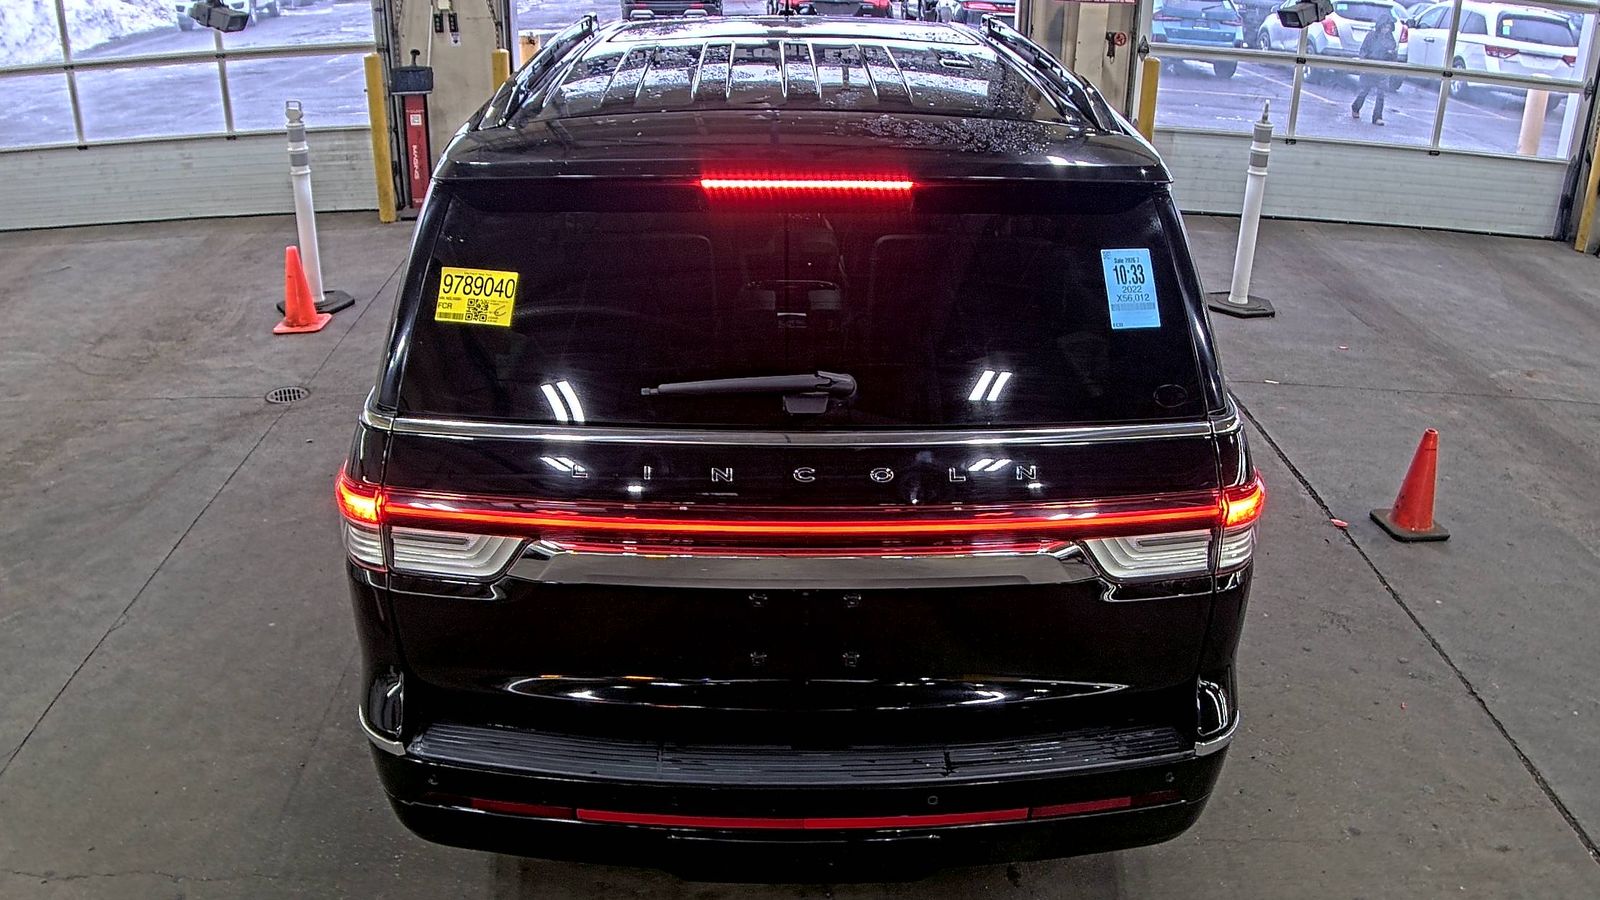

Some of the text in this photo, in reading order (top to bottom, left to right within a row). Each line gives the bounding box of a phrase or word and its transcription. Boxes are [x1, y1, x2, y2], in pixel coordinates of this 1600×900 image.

[1113, 264, 1145, 285] 10:33
[442, 273, 516, 299] 9789040
[1122, 285, 1142, 294] 2022
[1116, 293, 1151, 303] X56,012
[437, 301, 453, 310] FCR
[571, 464, 1038, 483] LINCOLN
